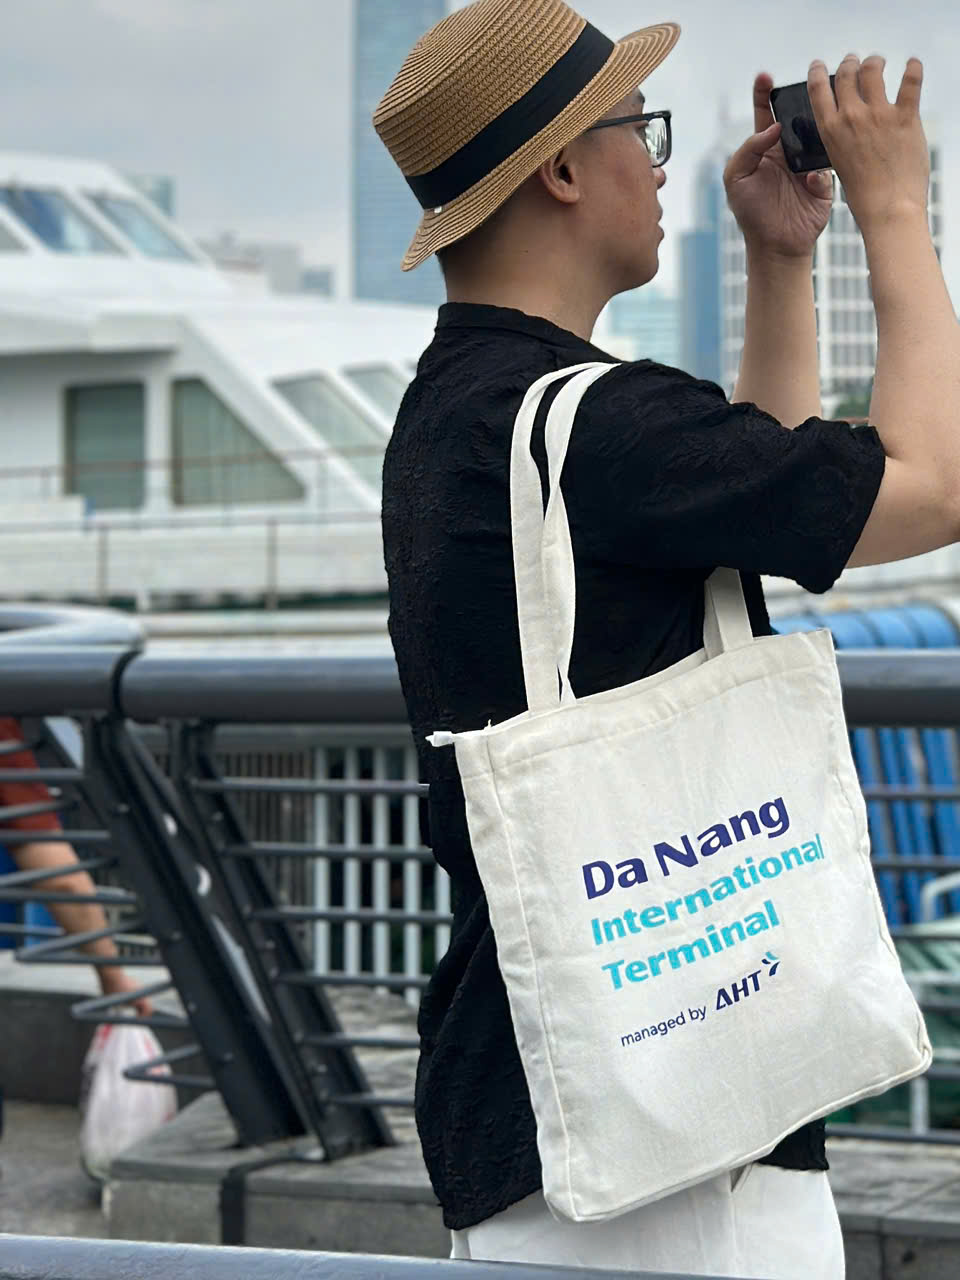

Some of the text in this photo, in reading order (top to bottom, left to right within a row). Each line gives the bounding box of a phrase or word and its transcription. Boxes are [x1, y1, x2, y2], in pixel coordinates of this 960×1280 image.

[582, 796, 790, 900] Da Nang
[591, 833, 825, 946] International
[601, 900, 780, 991] Terminal
[621, 970, 761, 1047] managed by AHT
